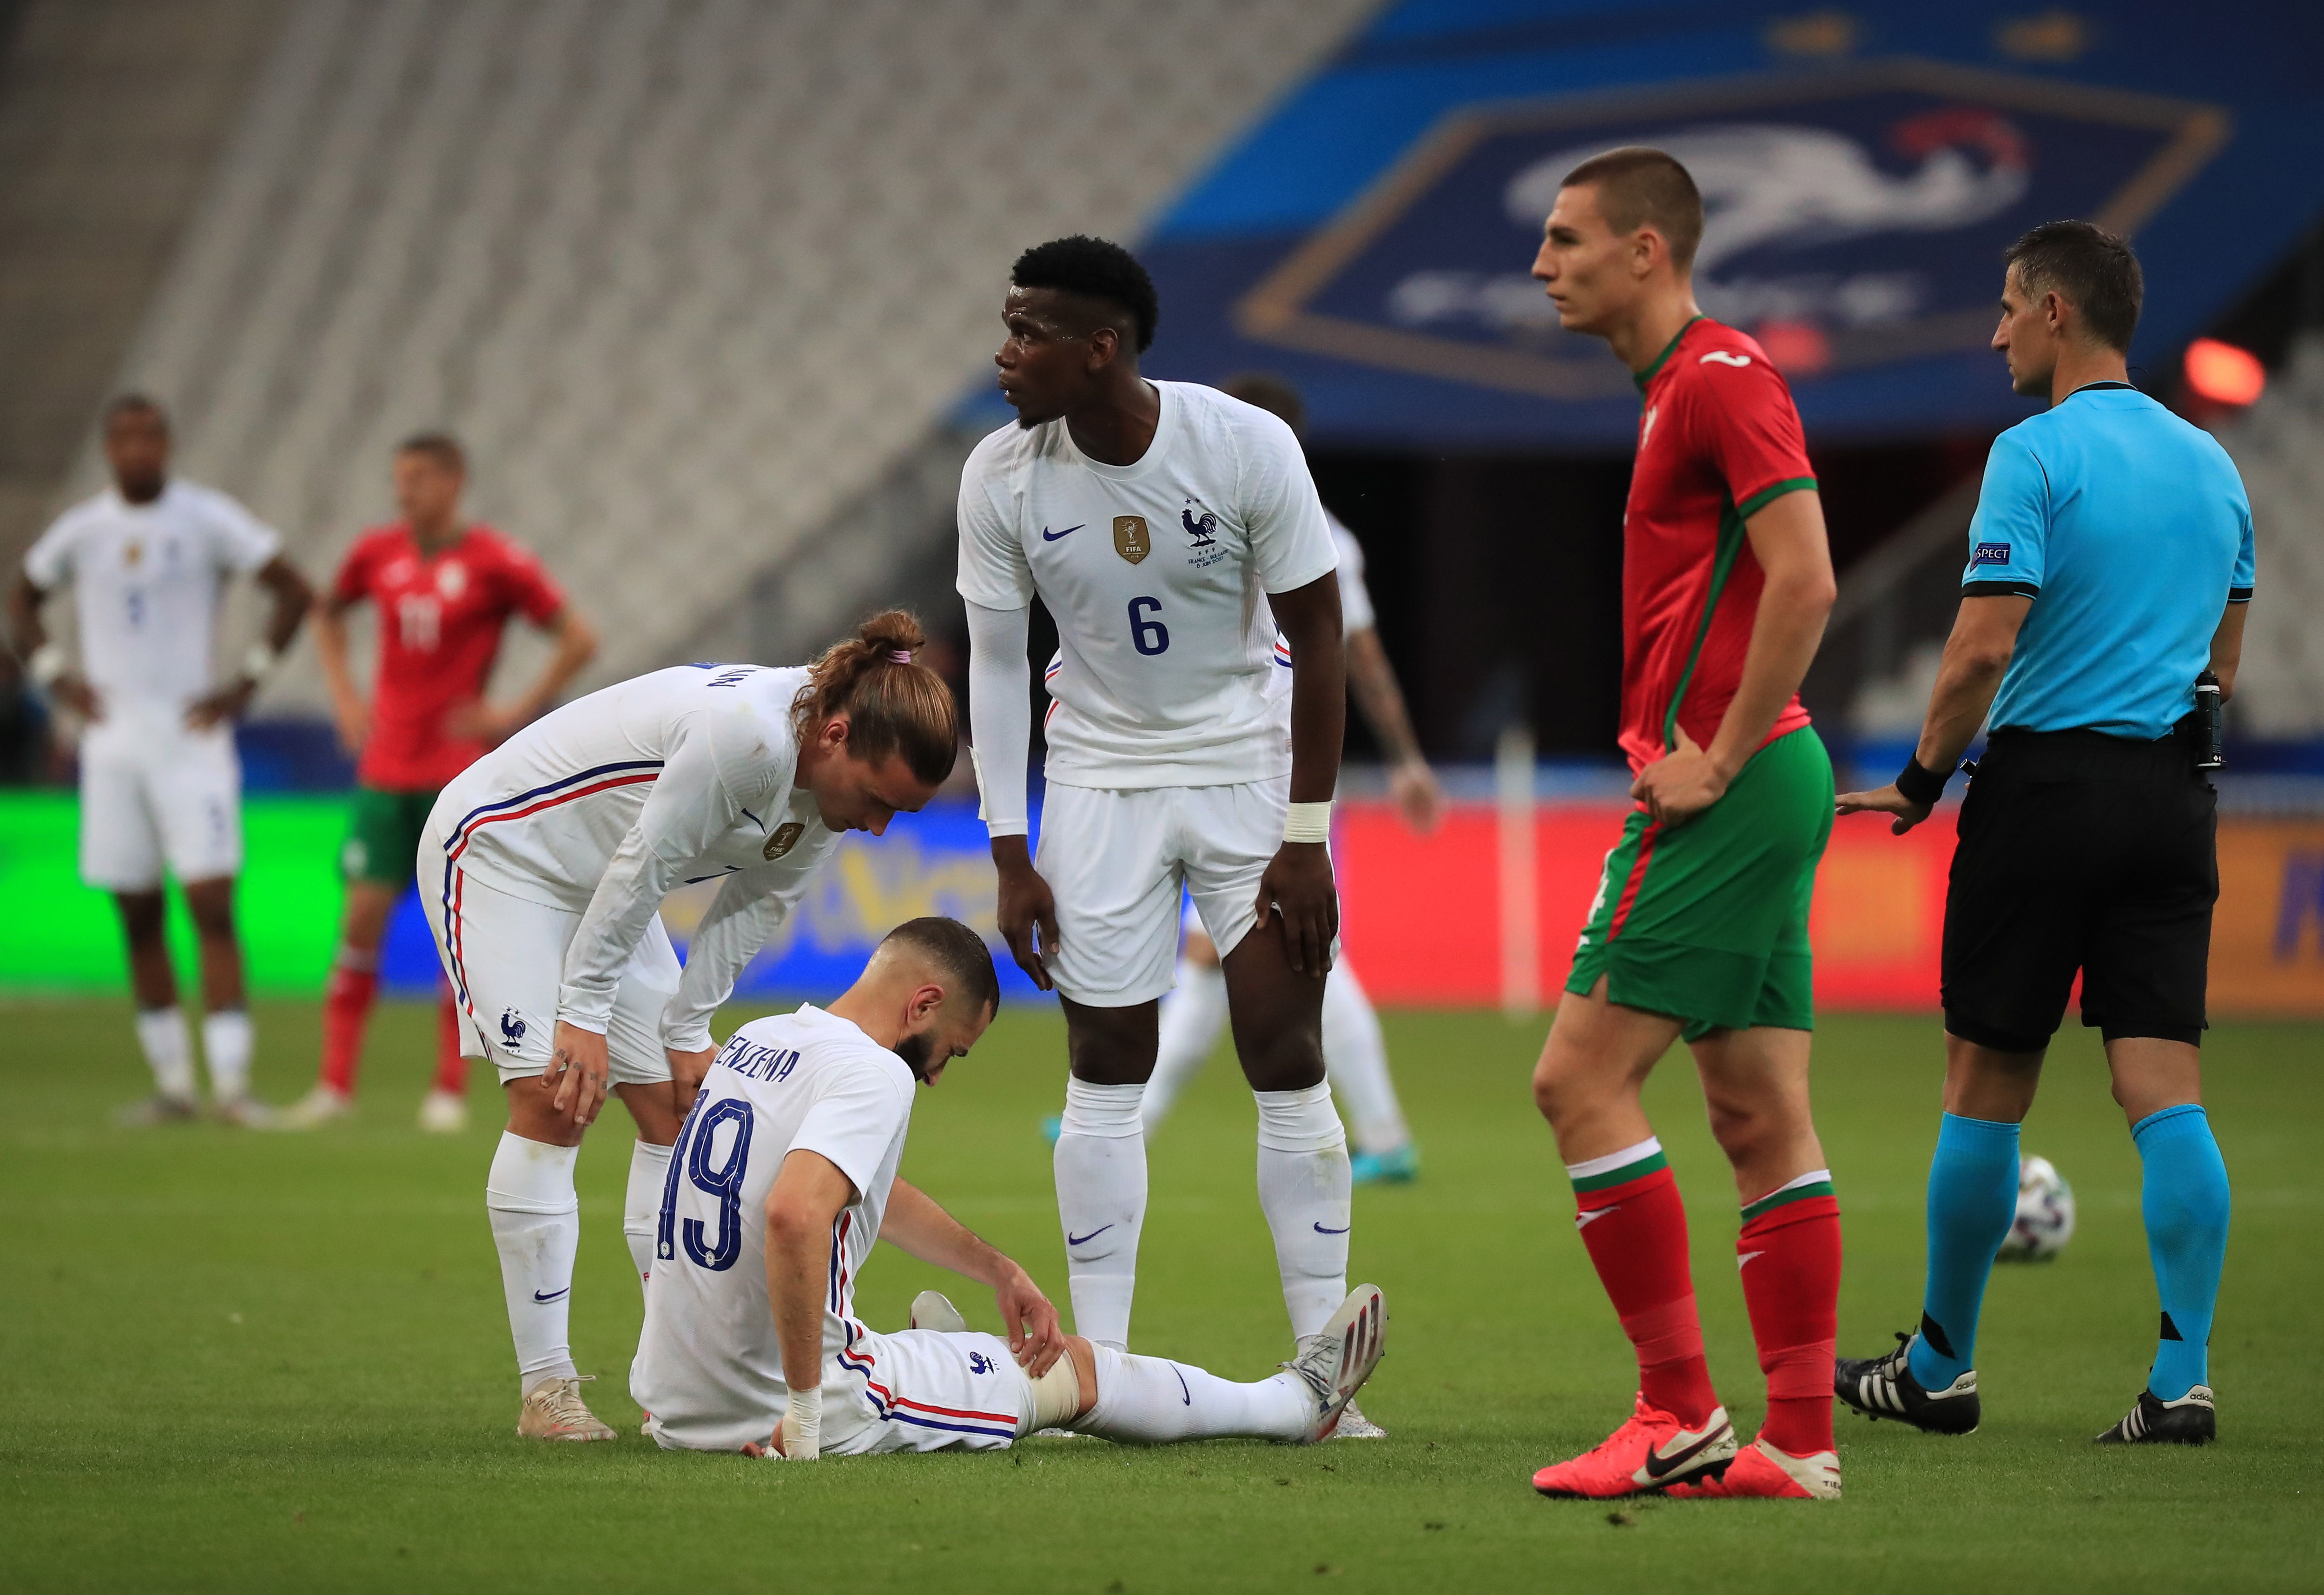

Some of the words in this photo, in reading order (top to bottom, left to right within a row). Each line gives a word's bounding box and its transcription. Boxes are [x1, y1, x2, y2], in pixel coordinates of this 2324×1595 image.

[1977, 549, 2009, 558] SPECT
[1128, 596, 1169, 656] 6
[657, 1089, 754, 1271] 19
[1956, 1379, 1976, 1390] adida
[2190, 1393, 2213, 1404] adida
